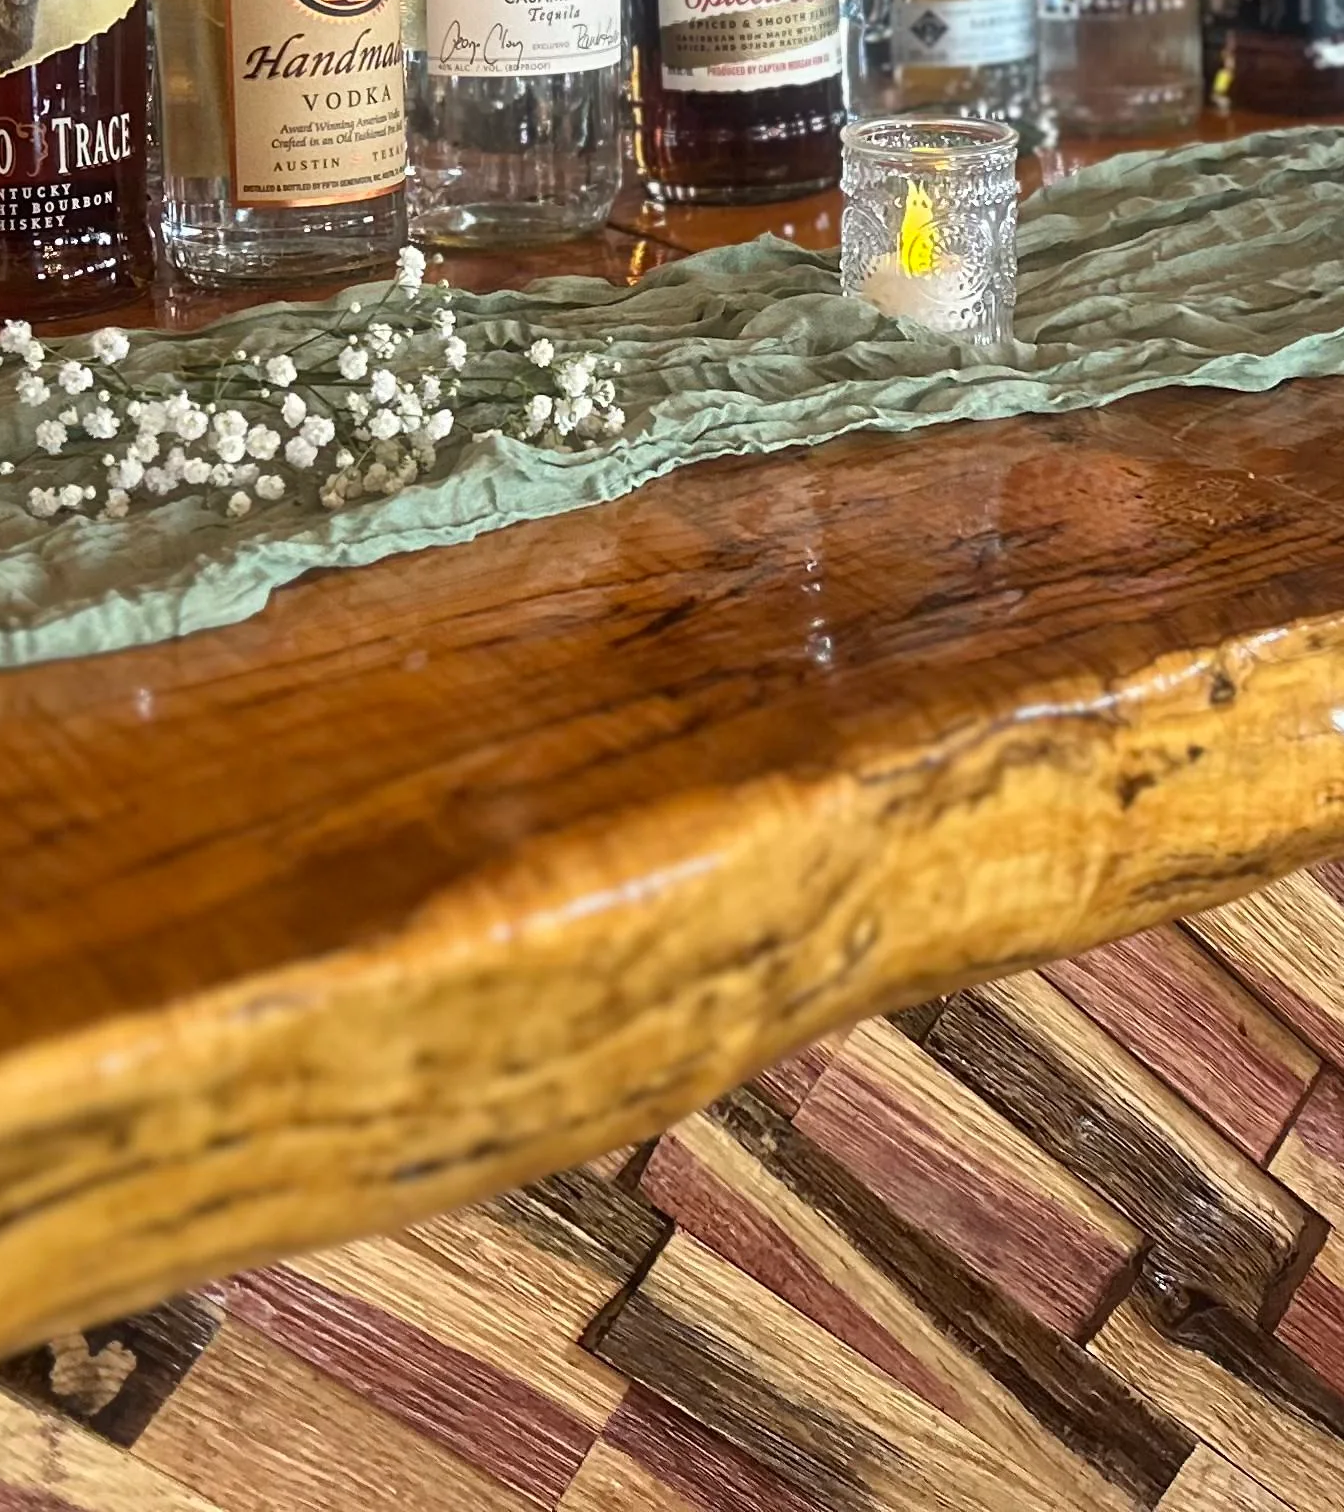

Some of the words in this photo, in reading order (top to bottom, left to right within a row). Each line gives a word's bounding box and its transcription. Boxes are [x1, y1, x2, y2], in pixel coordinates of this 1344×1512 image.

[527, 6, 581, 26] Tequila
[689, 19, 737, 30] SPICED
[742, 19, 751, 29] &
[756, 14, 806, 28] SMOOTH
[302, 83, 392, 112] VODKA
[51, 112, 132, 175] TRACE
[336, 130, 352, 144] Old
[272, 157, 341, 173] AUSTIN
[32, 190, 114, 216] BOURBON
